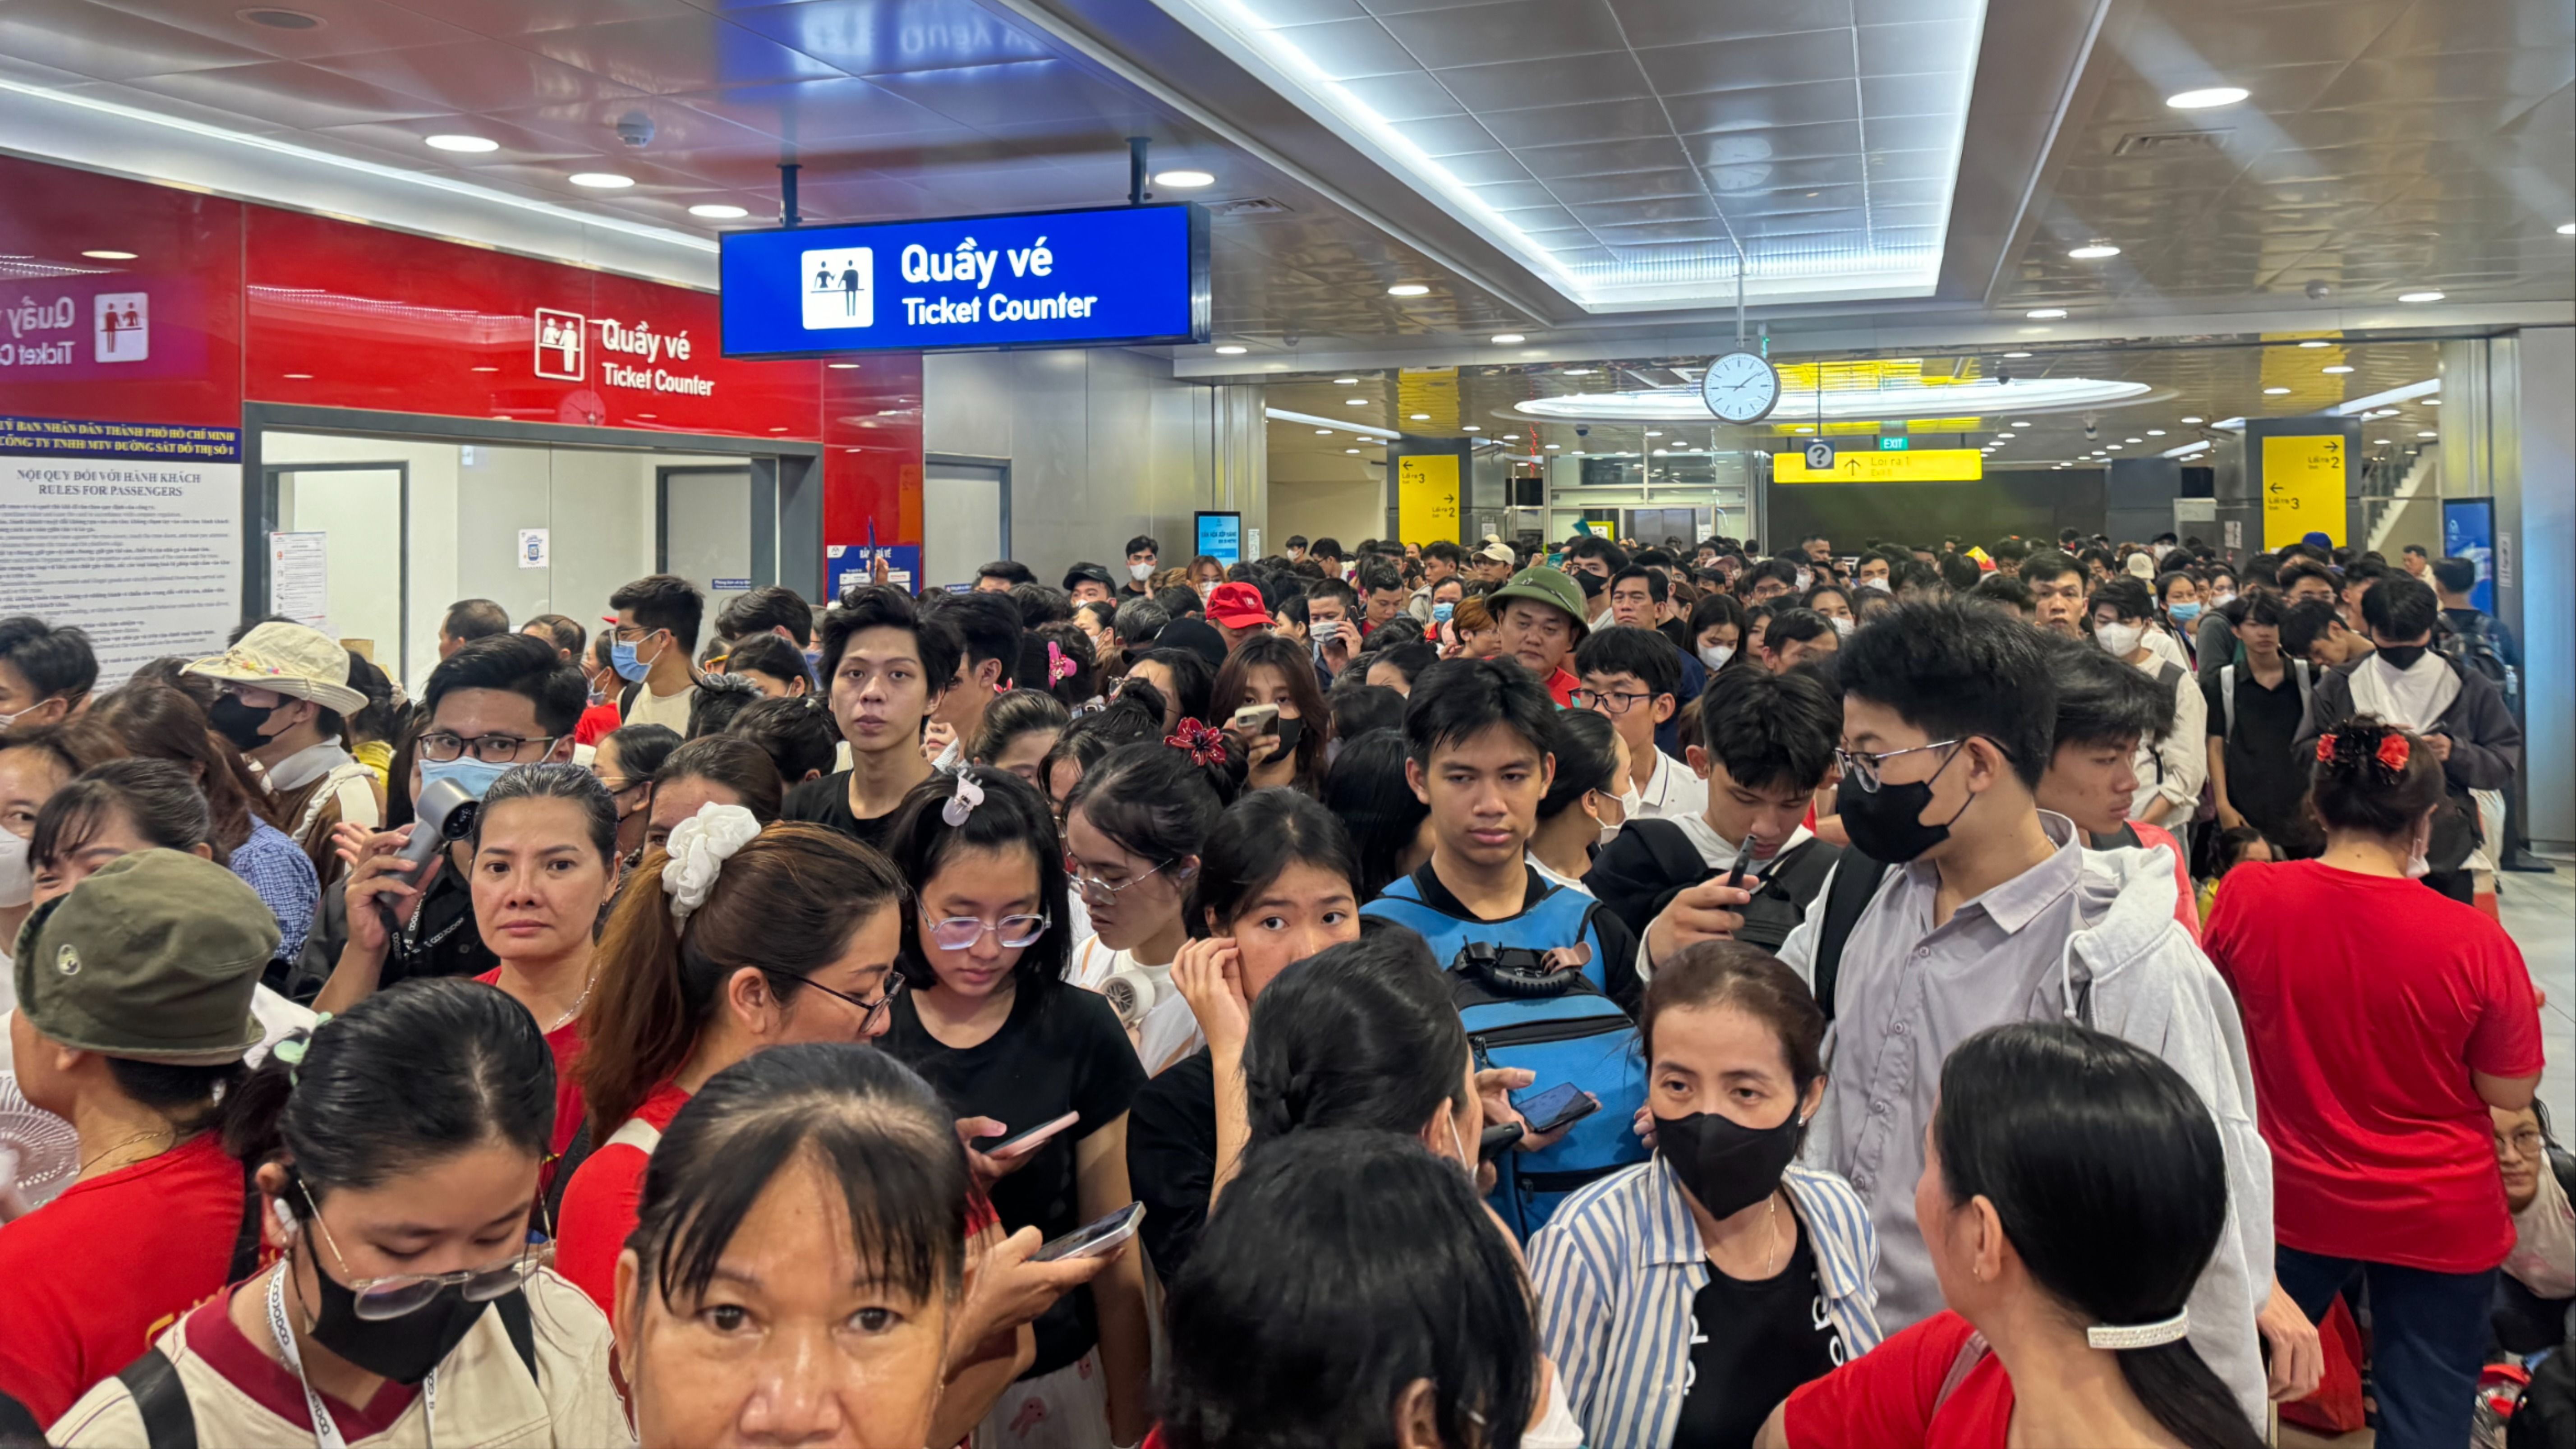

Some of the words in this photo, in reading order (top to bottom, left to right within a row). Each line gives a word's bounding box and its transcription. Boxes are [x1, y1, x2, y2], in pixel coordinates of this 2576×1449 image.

[902, 237, 998, 290] Quầy
[1007, 236, 1053, 277] vé
[902, 296, 981, 325] Ticket
[989, 292, 1098, 322] Counter
[602, 318, 661, 363] Quầy
[664, 330, 691, 360] vé
[602, 362, 652, 390] Ticket
[655, 369, 715, 396] Counter
[17, 421, 42, 432] BAN
[207, 431, 235, 442] MINH
[36, 438, 51, 448] TY
[54, 439, 86, 449] TNHH
[88, 440, 112, 450] MTV
[1883, 438, 1903, 449] EXIT
[2331, 457, 2340, 469] 2
[43, 469, 70, 482] QUY
[124, 469, 157, 483] HÀNH
[160, 471, 201, 483] KHÁCH
[1419, 473, 1425, 484] 3
[39, 484, 81, 495] RULES
[83, 485, 107, 496] FOR
[110, 486, 182, 496] PASSENGERS
[2291, 497, 2300, 510] 3
[1449, 506, 1455, 517] 2
